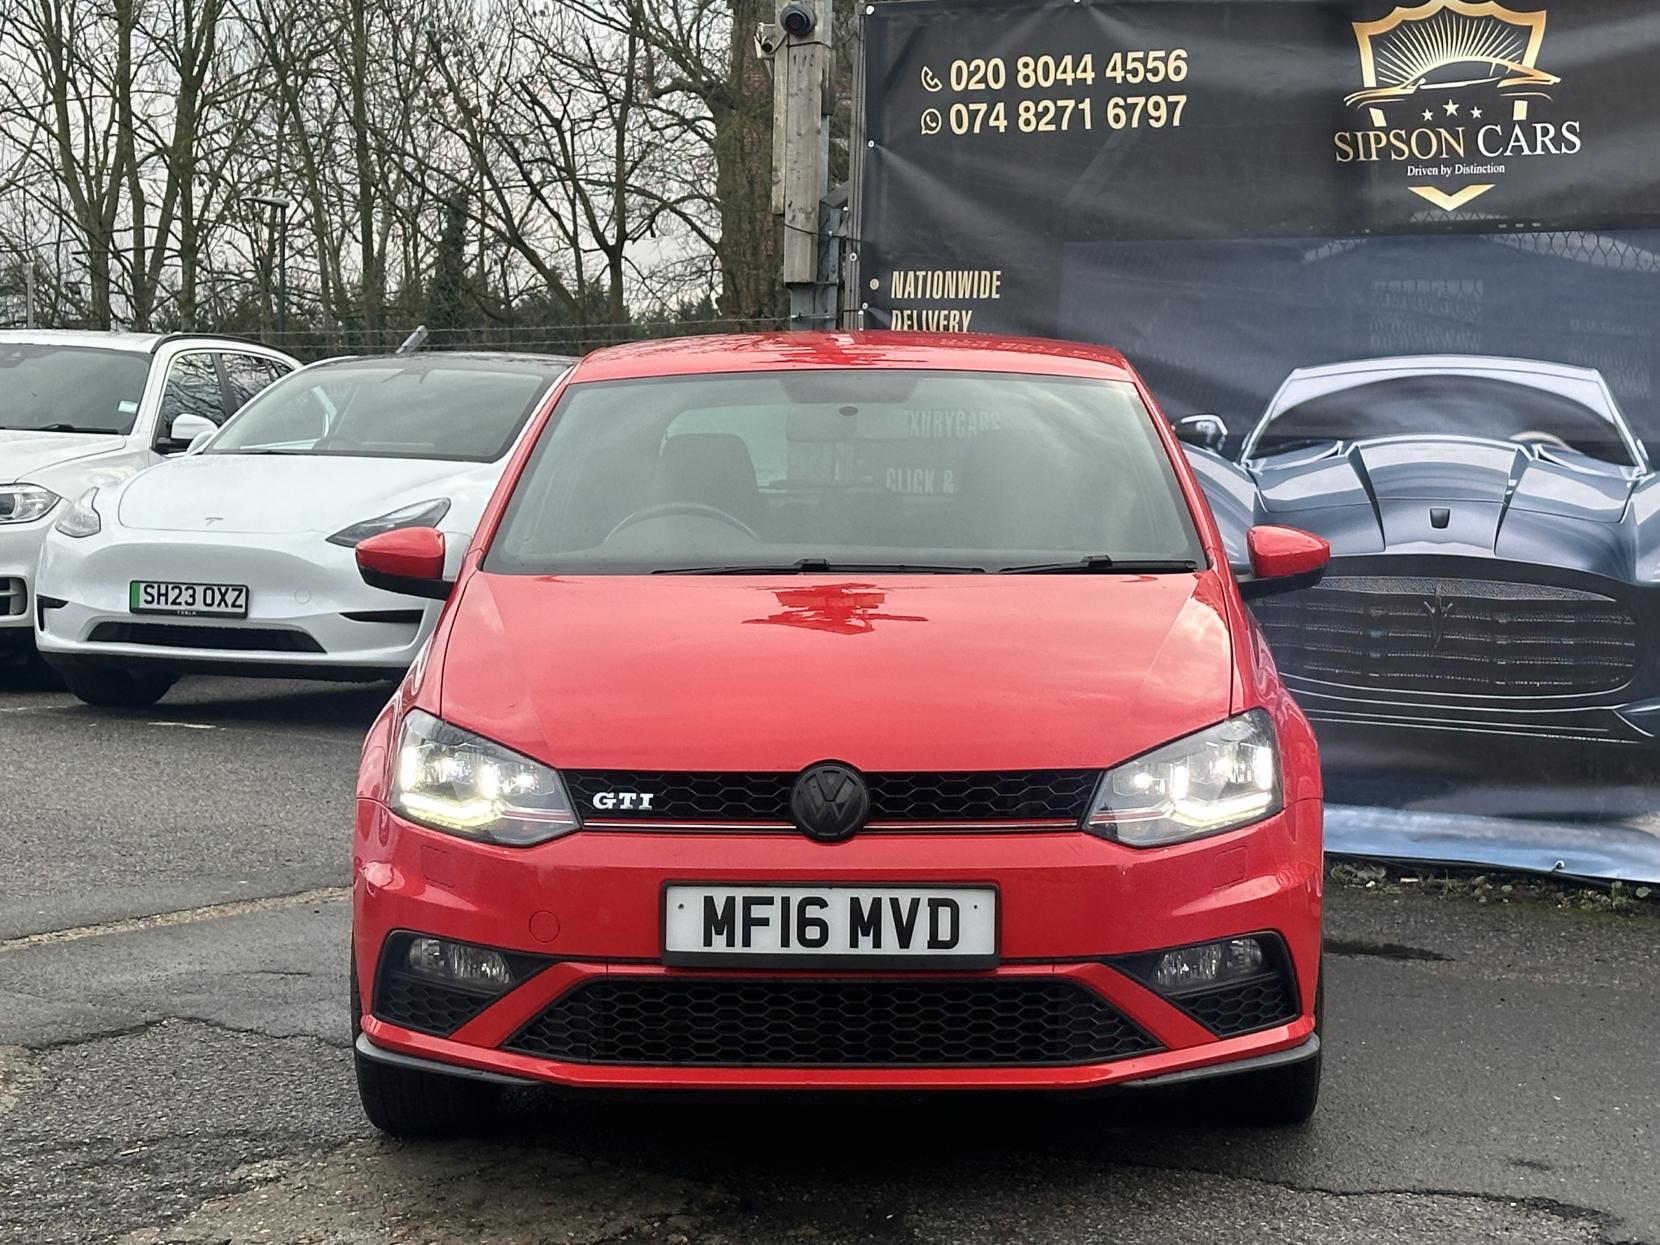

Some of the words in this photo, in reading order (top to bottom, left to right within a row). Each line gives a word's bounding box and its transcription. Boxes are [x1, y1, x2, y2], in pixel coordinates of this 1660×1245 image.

[950, 59, 1006, 91] 020
[1016, 54, 1095, 88] 8044
[1105, 49, 1188, 84] 4556
[949, 103, 1008, 135] 074
[1018, 98, 1092, 132] 8271
[1106, 95, 1187, 130] 6797
[1333, 127, 1466, 163] SIPSON
[1477, 120, 1581, 157] CARS
[1407, 165, 1439, 176] Driven
[1440, 164, 1452, 178] by
[1455, 162, 1505, 175] Distinction
[891, 270, 1001, 299] NATIONWIDE
[891, 309, 973, 333] DELIVERY
[886, 467, 935, 494] CLICK
[143, 584, 197, 606] SH23
[202, 587, 244, 609] OXZ
[593, 792, 654, 810] GTI
[702, 895, 830, 949] MF16
[849, 896, 960, 950] MVD
